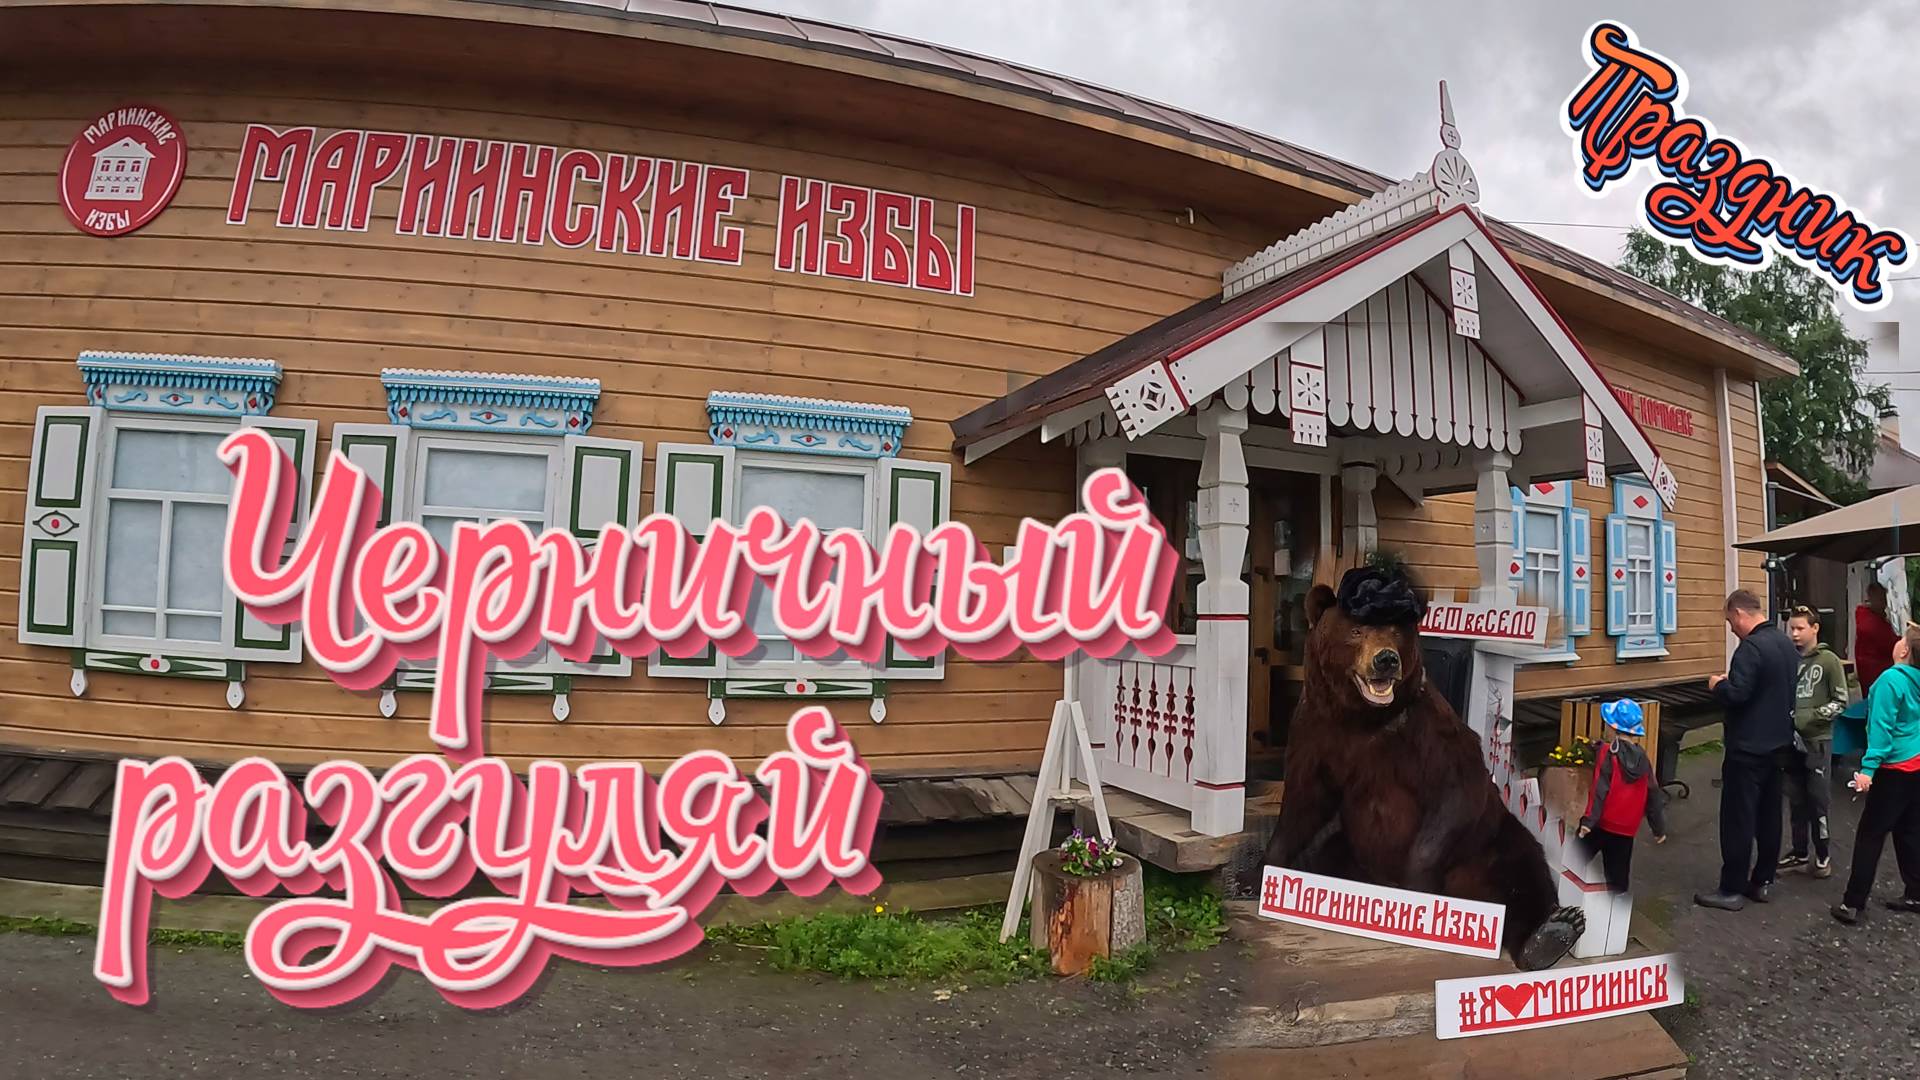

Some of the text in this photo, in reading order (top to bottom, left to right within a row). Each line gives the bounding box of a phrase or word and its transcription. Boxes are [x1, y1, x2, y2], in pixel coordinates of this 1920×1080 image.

[83, 108, 176, 145] МАРИИНСКИЕ
[84, 209, 130, 230] ИЗБЫ
[225, 122, 977, 298] МАРИИНСКИЕ ИЗБЫ
